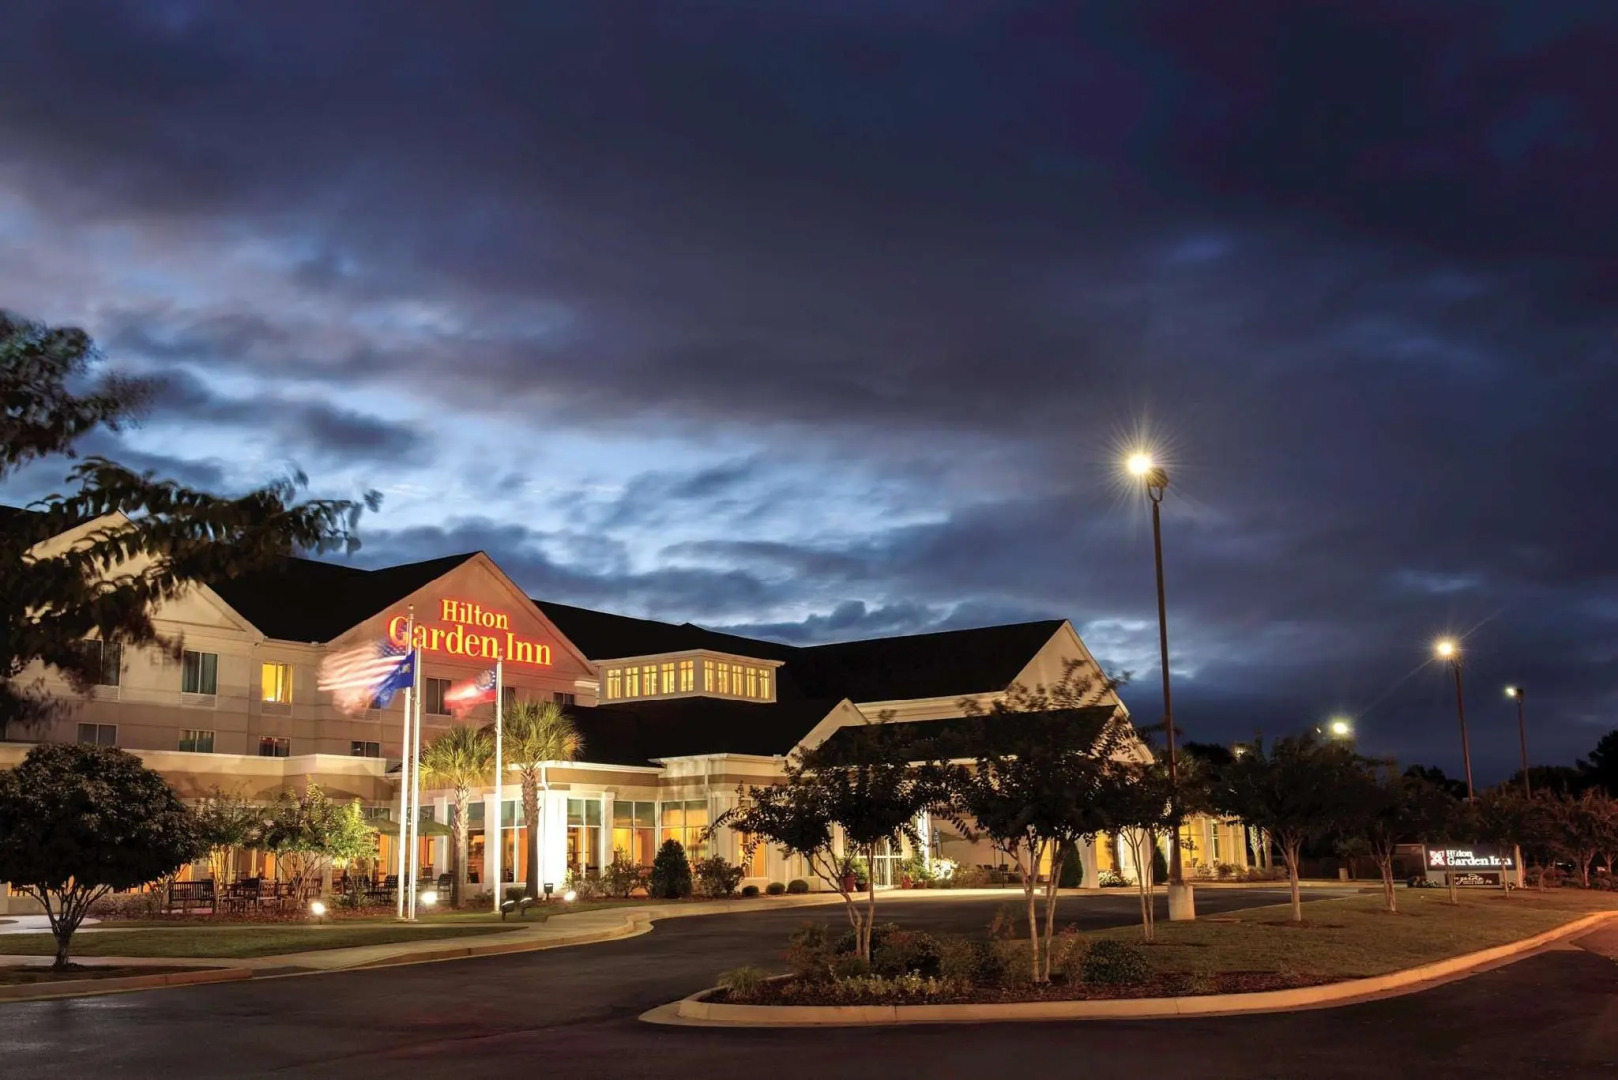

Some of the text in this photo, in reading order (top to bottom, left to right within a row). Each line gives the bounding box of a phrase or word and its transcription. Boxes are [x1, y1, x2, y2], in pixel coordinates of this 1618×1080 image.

[441, 599, 509, 630] Hilton
[389, 616, 552, 666] Garden Inn
[1447, 855, 1489, 866] Garden
